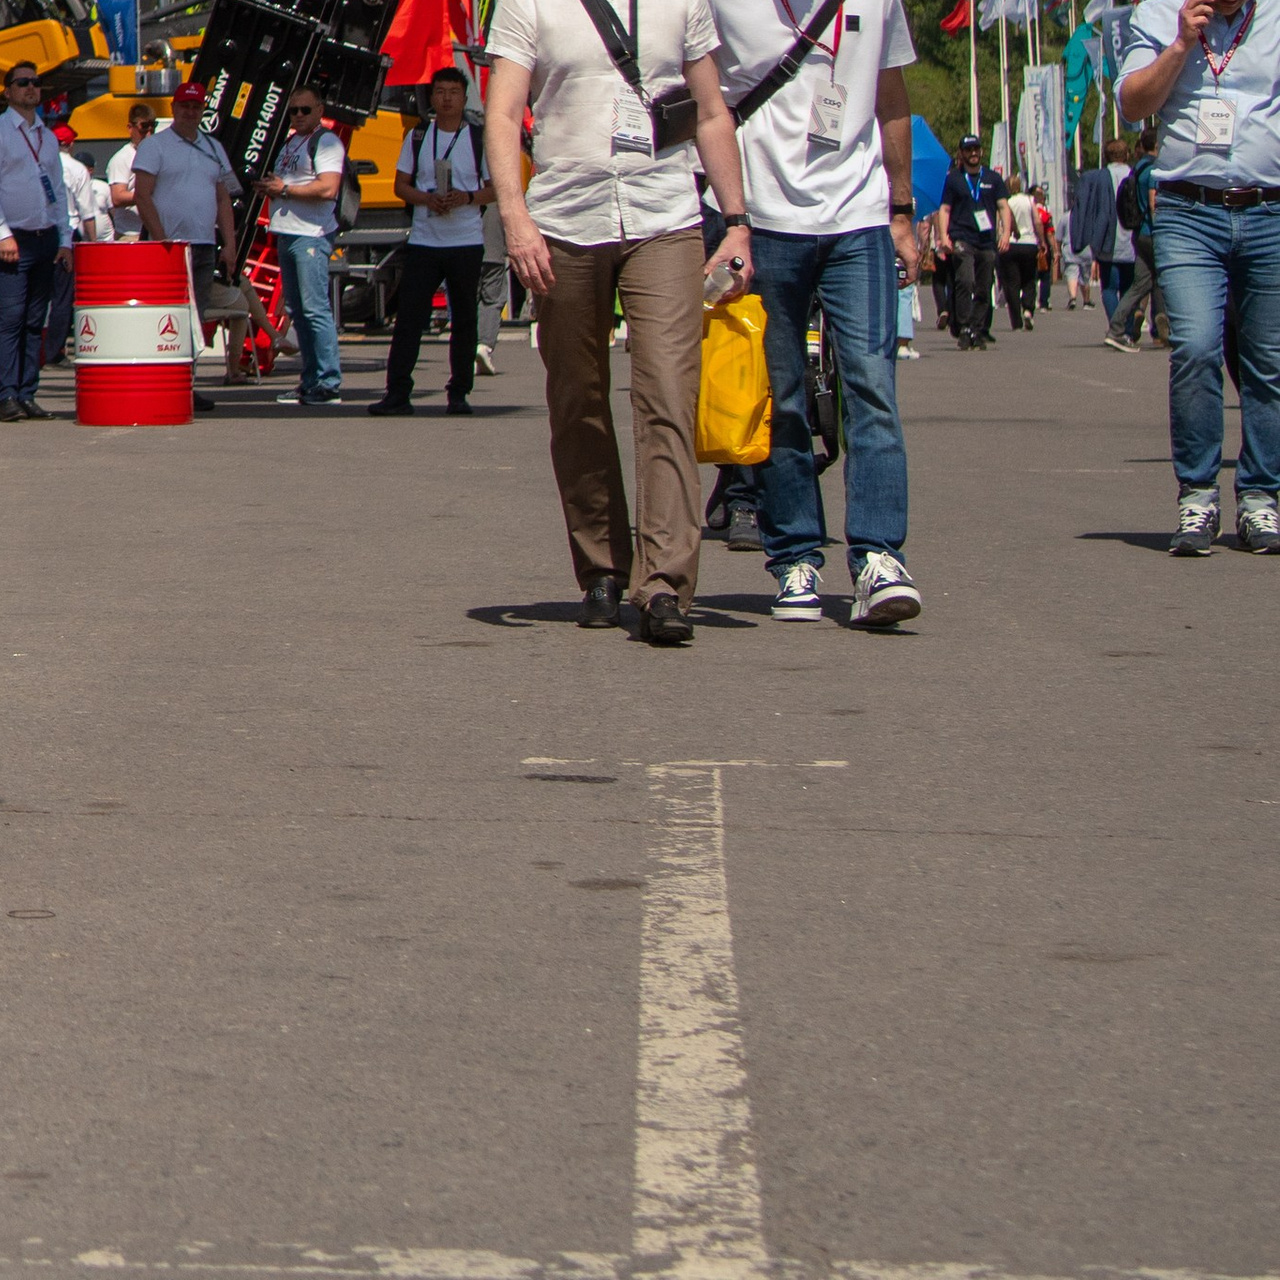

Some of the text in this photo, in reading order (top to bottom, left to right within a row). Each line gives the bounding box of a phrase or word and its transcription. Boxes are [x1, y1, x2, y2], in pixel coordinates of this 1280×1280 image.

[209, 68, 230, 110] SANY
[244, 81, 283, 163] SYB1400T
[78, 344, 99, 353] SANY
[157, 343, 181, 352] SANY
